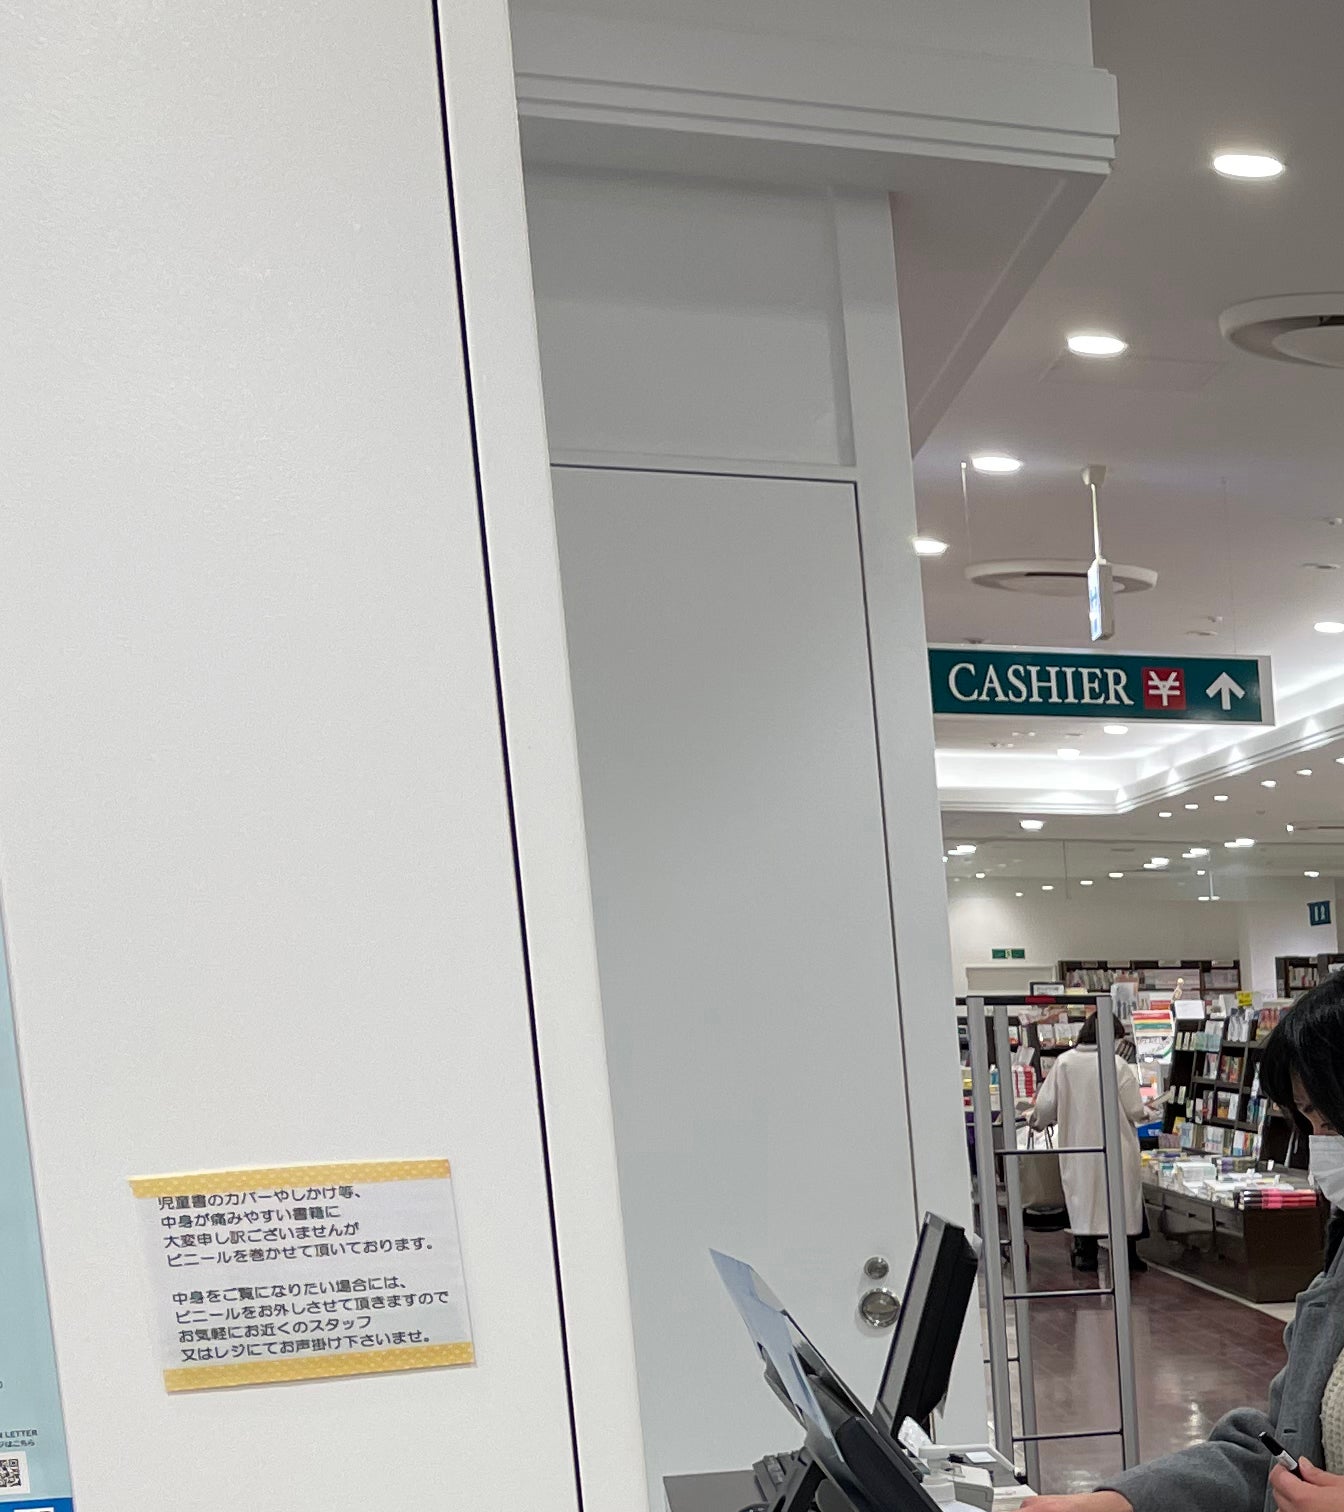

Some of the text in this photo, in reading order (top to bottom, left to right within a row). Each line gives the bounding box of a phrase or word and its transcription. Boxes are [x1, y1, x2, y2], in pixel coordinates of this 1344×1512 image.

[949, 663, 1134, 705] CASHIER
[160, 1205, 341, 1229] 中身が痛みやすい書籍に
[163, 1222, 360, 1249] 大変申し訳ございませんが
[178, 1315, 372, 1343] お気軽にお近くのスタッフ
[181, 1332, 431, 1363] 又はレジにてお声掛け下さいませ。
[5, 1429, 38, 1438] LETTER
